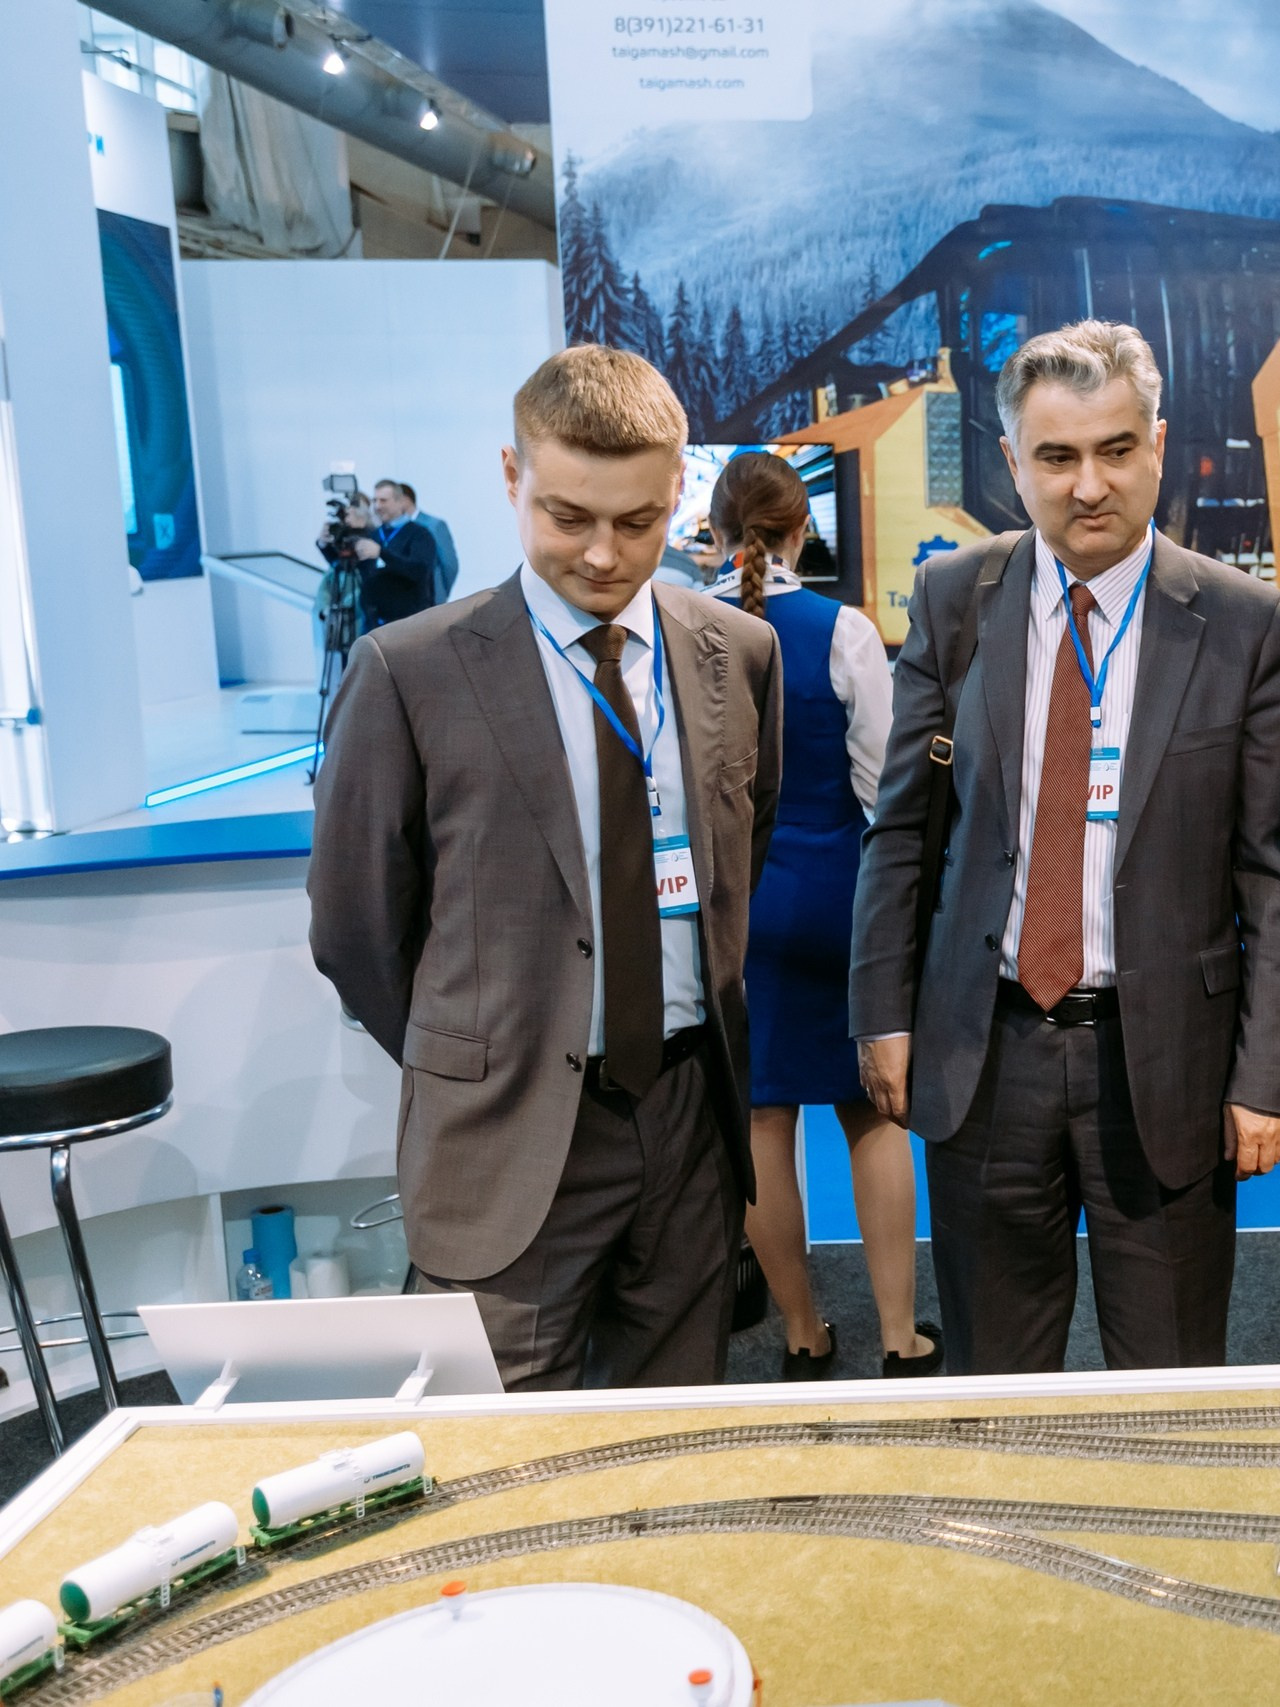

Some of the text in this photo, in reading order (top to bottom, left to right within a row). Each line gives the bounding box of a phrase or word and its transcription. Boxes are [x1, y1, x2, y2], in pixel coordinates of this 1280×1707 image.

[613, 16, 765, 37] 8(391)221-61-31
[611, 46, 769, 60] taigamash@gmail.com
[639, 77, 745, 91] taigamash.com
[656, 875, 688, 896] VIP
